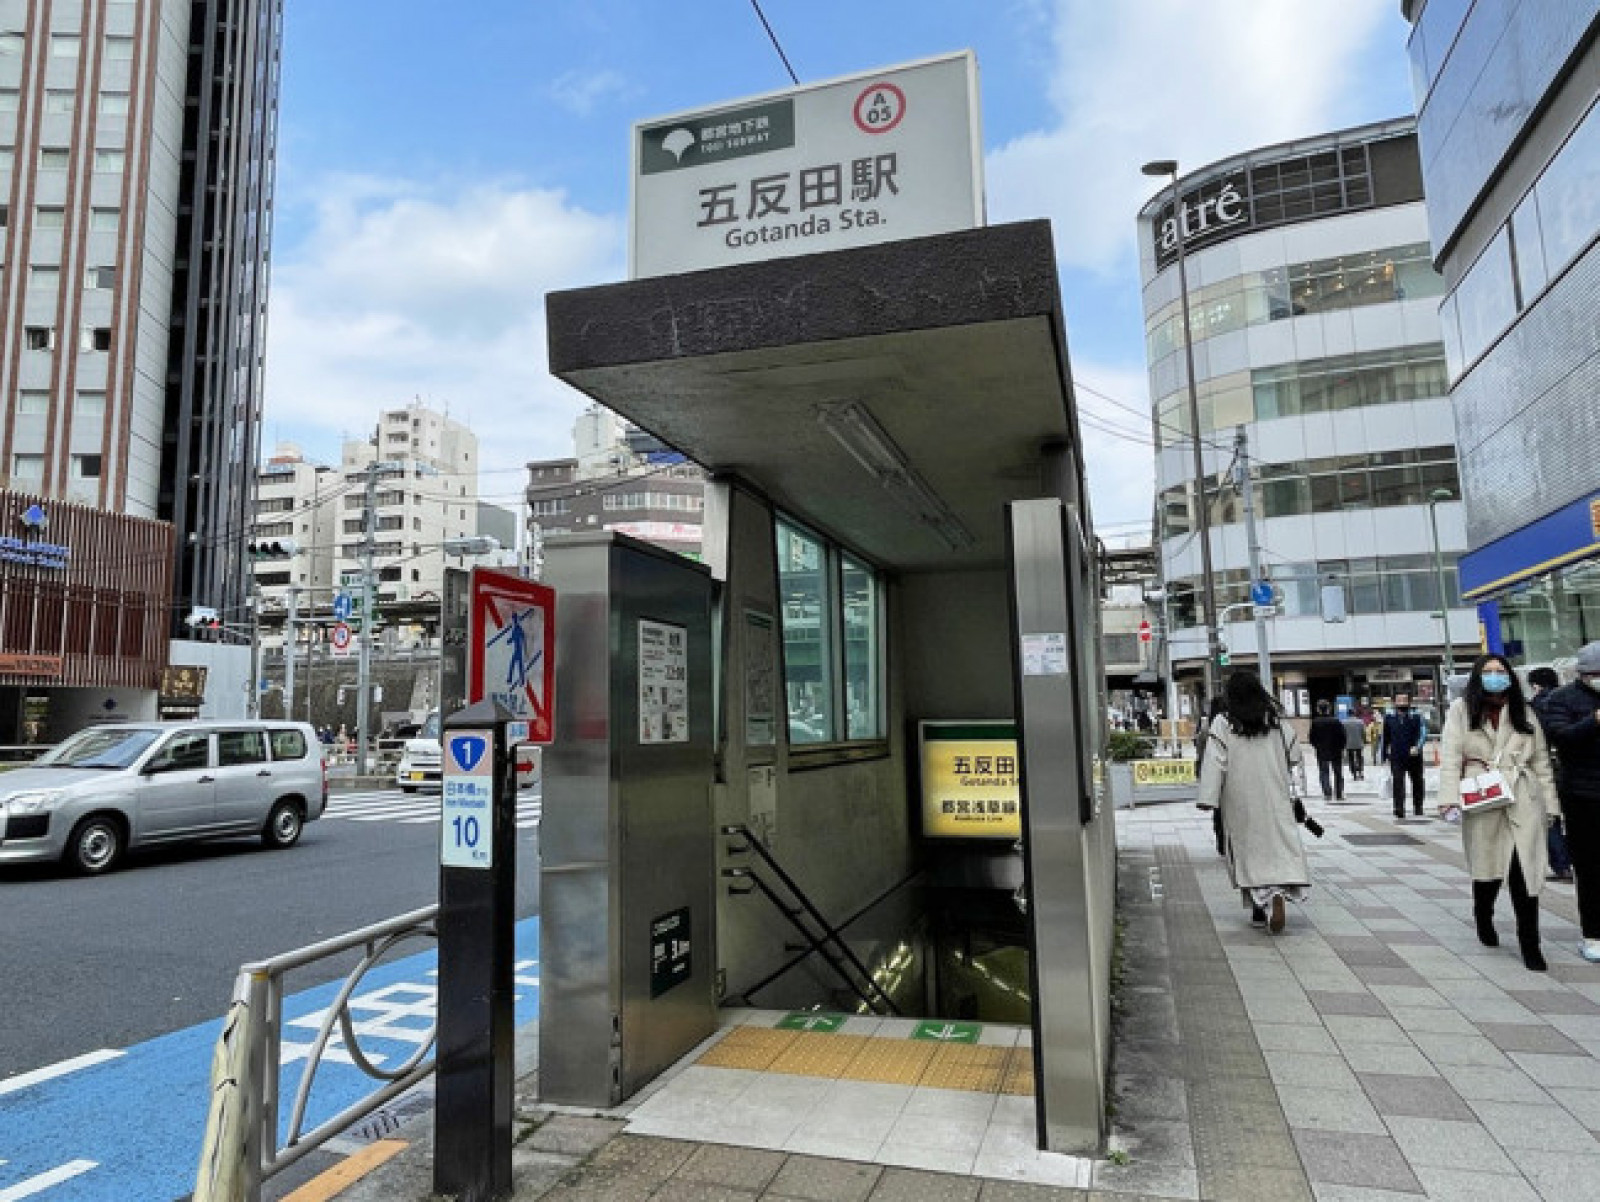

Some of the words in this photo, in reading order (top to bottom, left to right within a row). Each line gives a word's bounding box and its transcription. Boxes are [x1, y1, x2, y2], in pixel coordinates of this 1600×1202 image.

[873, 93, 887, 106] A
[867, 106, 892, 123] 05
[697, 152, 899, 227] 五反田駅
[725, 214, 831, 247] Gotanda
[839, 208, 887, 231] Sta.
[1162, 183, 1242, 250] atré
[462, 741, 471, 765] 1
[953, 755, 1015, 775] 五反田
[453, 815, 479, 848] 10
